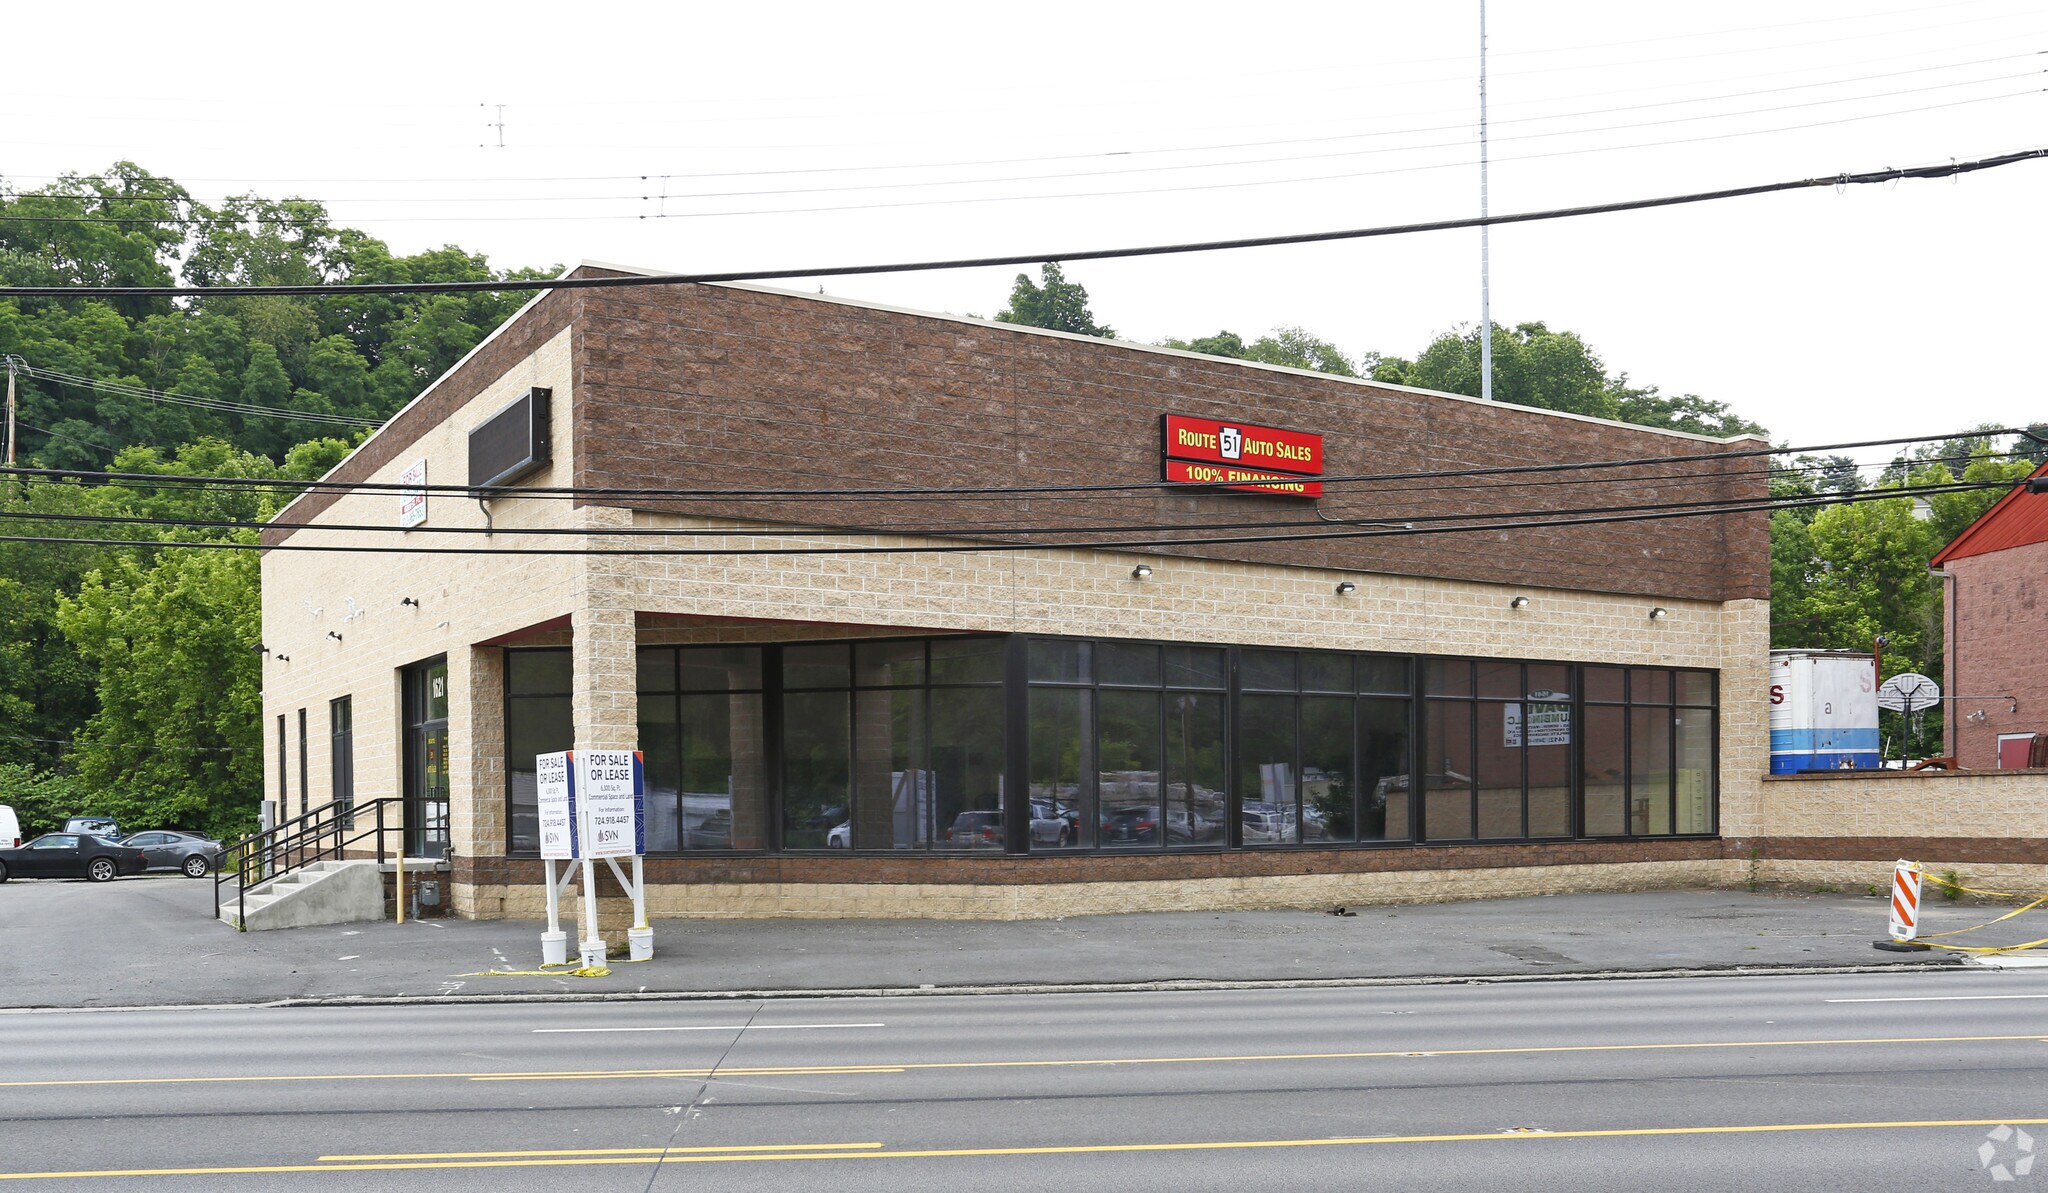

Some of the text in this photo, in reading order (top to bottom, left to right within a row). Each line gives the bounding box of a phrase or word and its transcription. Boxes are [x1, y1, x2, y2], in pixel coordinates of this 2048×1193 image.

[1178, 428, 1312, 462] ROUTE 51 AUTO SALES
[1186, 466, 1224, 483] 100%
[433, 676, 443, 698] 1621
[539, 756, 564, 769] FOR SALE
[590, 754, 629, 766] FOR SALE
[540, 771, 565, 784] OR LEASE
[591, 769, 630, 781] OR LEASE
[604, 830, 619, 841] SVN
